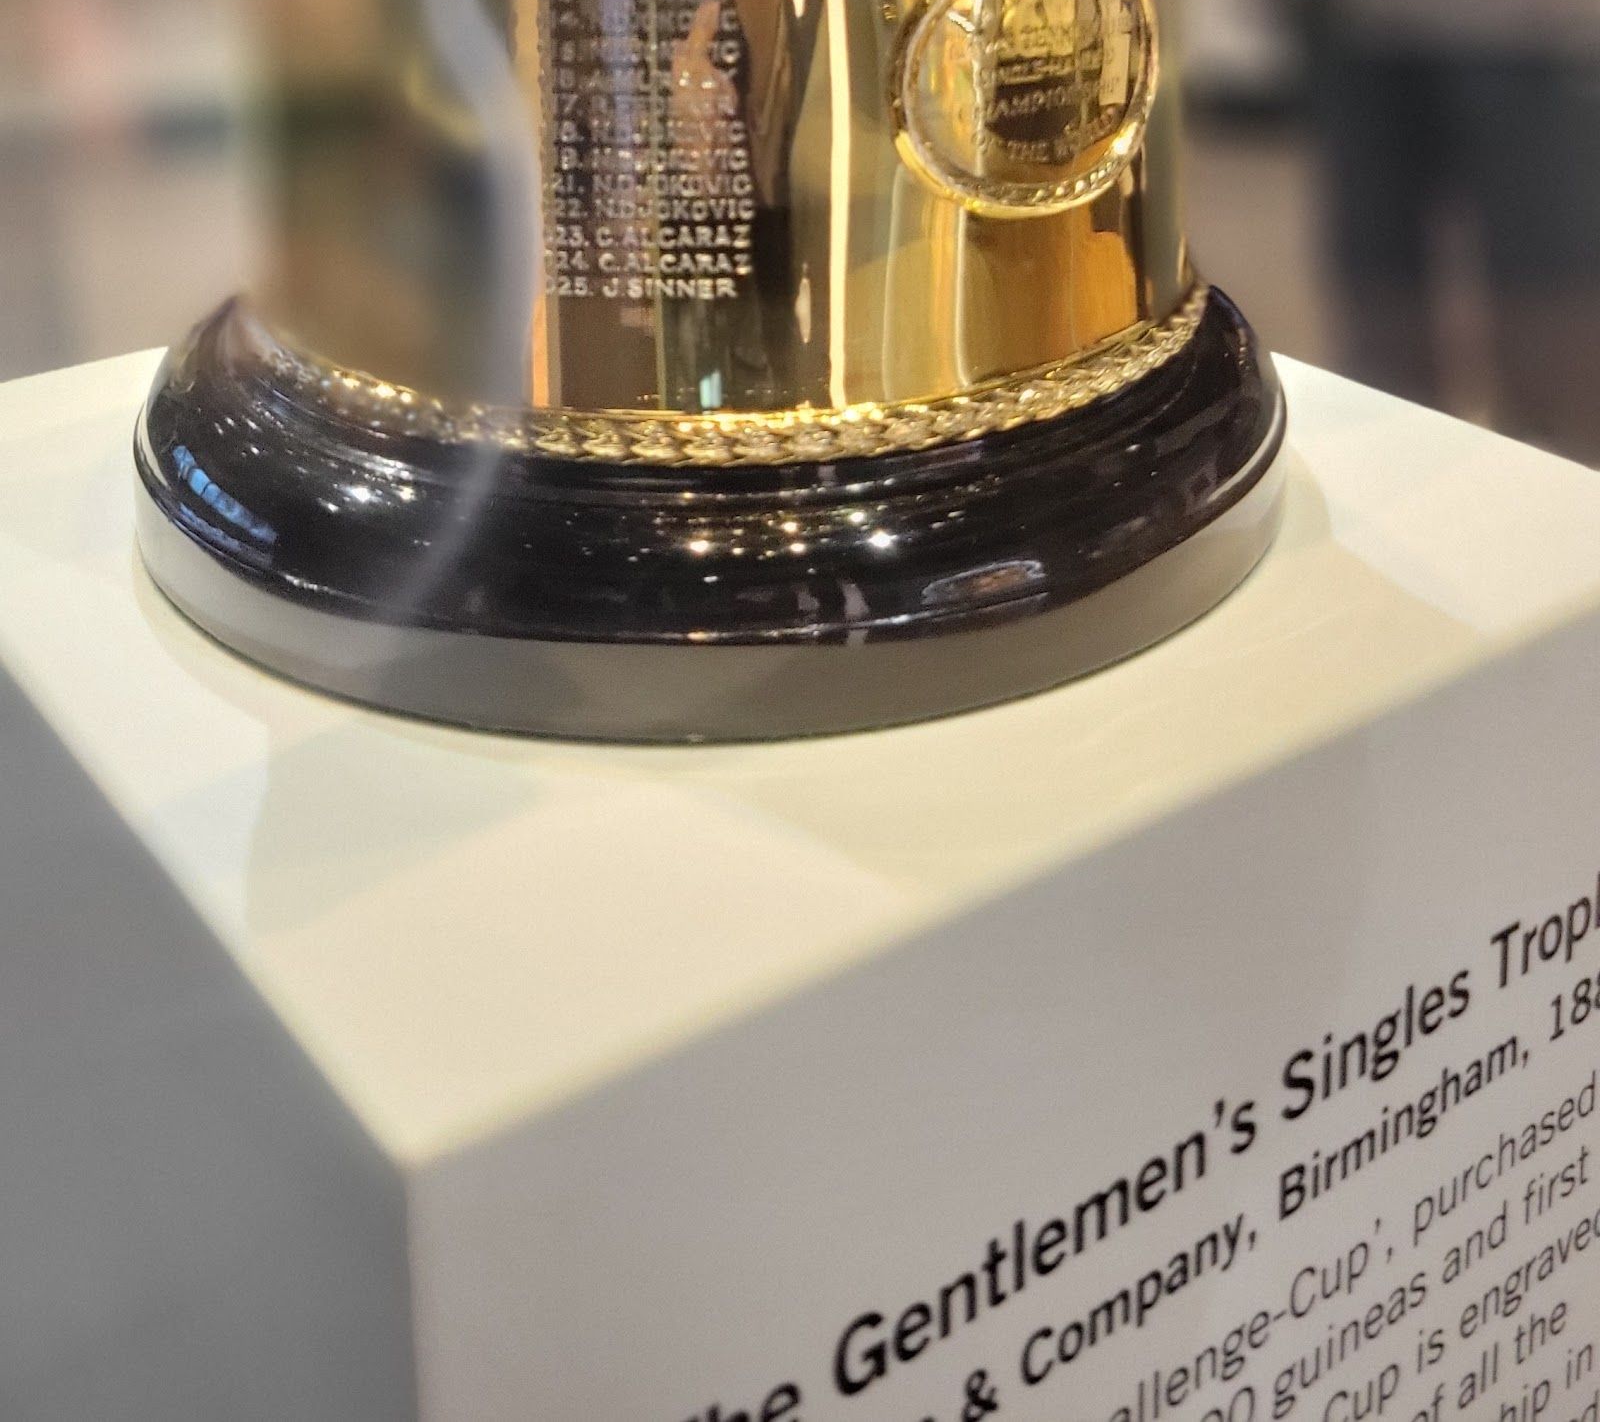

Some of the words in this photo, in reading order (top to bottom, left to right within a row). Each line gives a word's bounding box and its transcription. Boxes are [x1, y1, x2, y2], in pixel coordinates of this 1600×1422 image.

[596, 224, 751, 250] C.ALCARAZ
[599, 251, 753, 276] C.ALCARAZ
[602, 276, 738, 301] J.SINNER
[832, 1095, 1257, 1397] Gentlemen's
[1280, 969, 1471, 1120] Singles
[1490, 870, 1600, 989] Trop
[1412, 1069, 1596, 1247] purchased
[960, 1366, 999, 1422] &
[1019, 1211, 1257, 1386] Company,
[1278, 1033, 1530, 1222] Birmingham,
[1549, 970, 1600, 1042] 18
[1272, 1269, 1427, 1421] guineas
[1441, 1198, 1507, 1285] and
[1523, 1144, 1589, 1226] first
[1417, 1328, 1445, 1374] is
[1457, 1341, 1499, 1410] all
[1514, 1301, 1567, 1365] the
[1565, 1343, 1594, 1390] in
